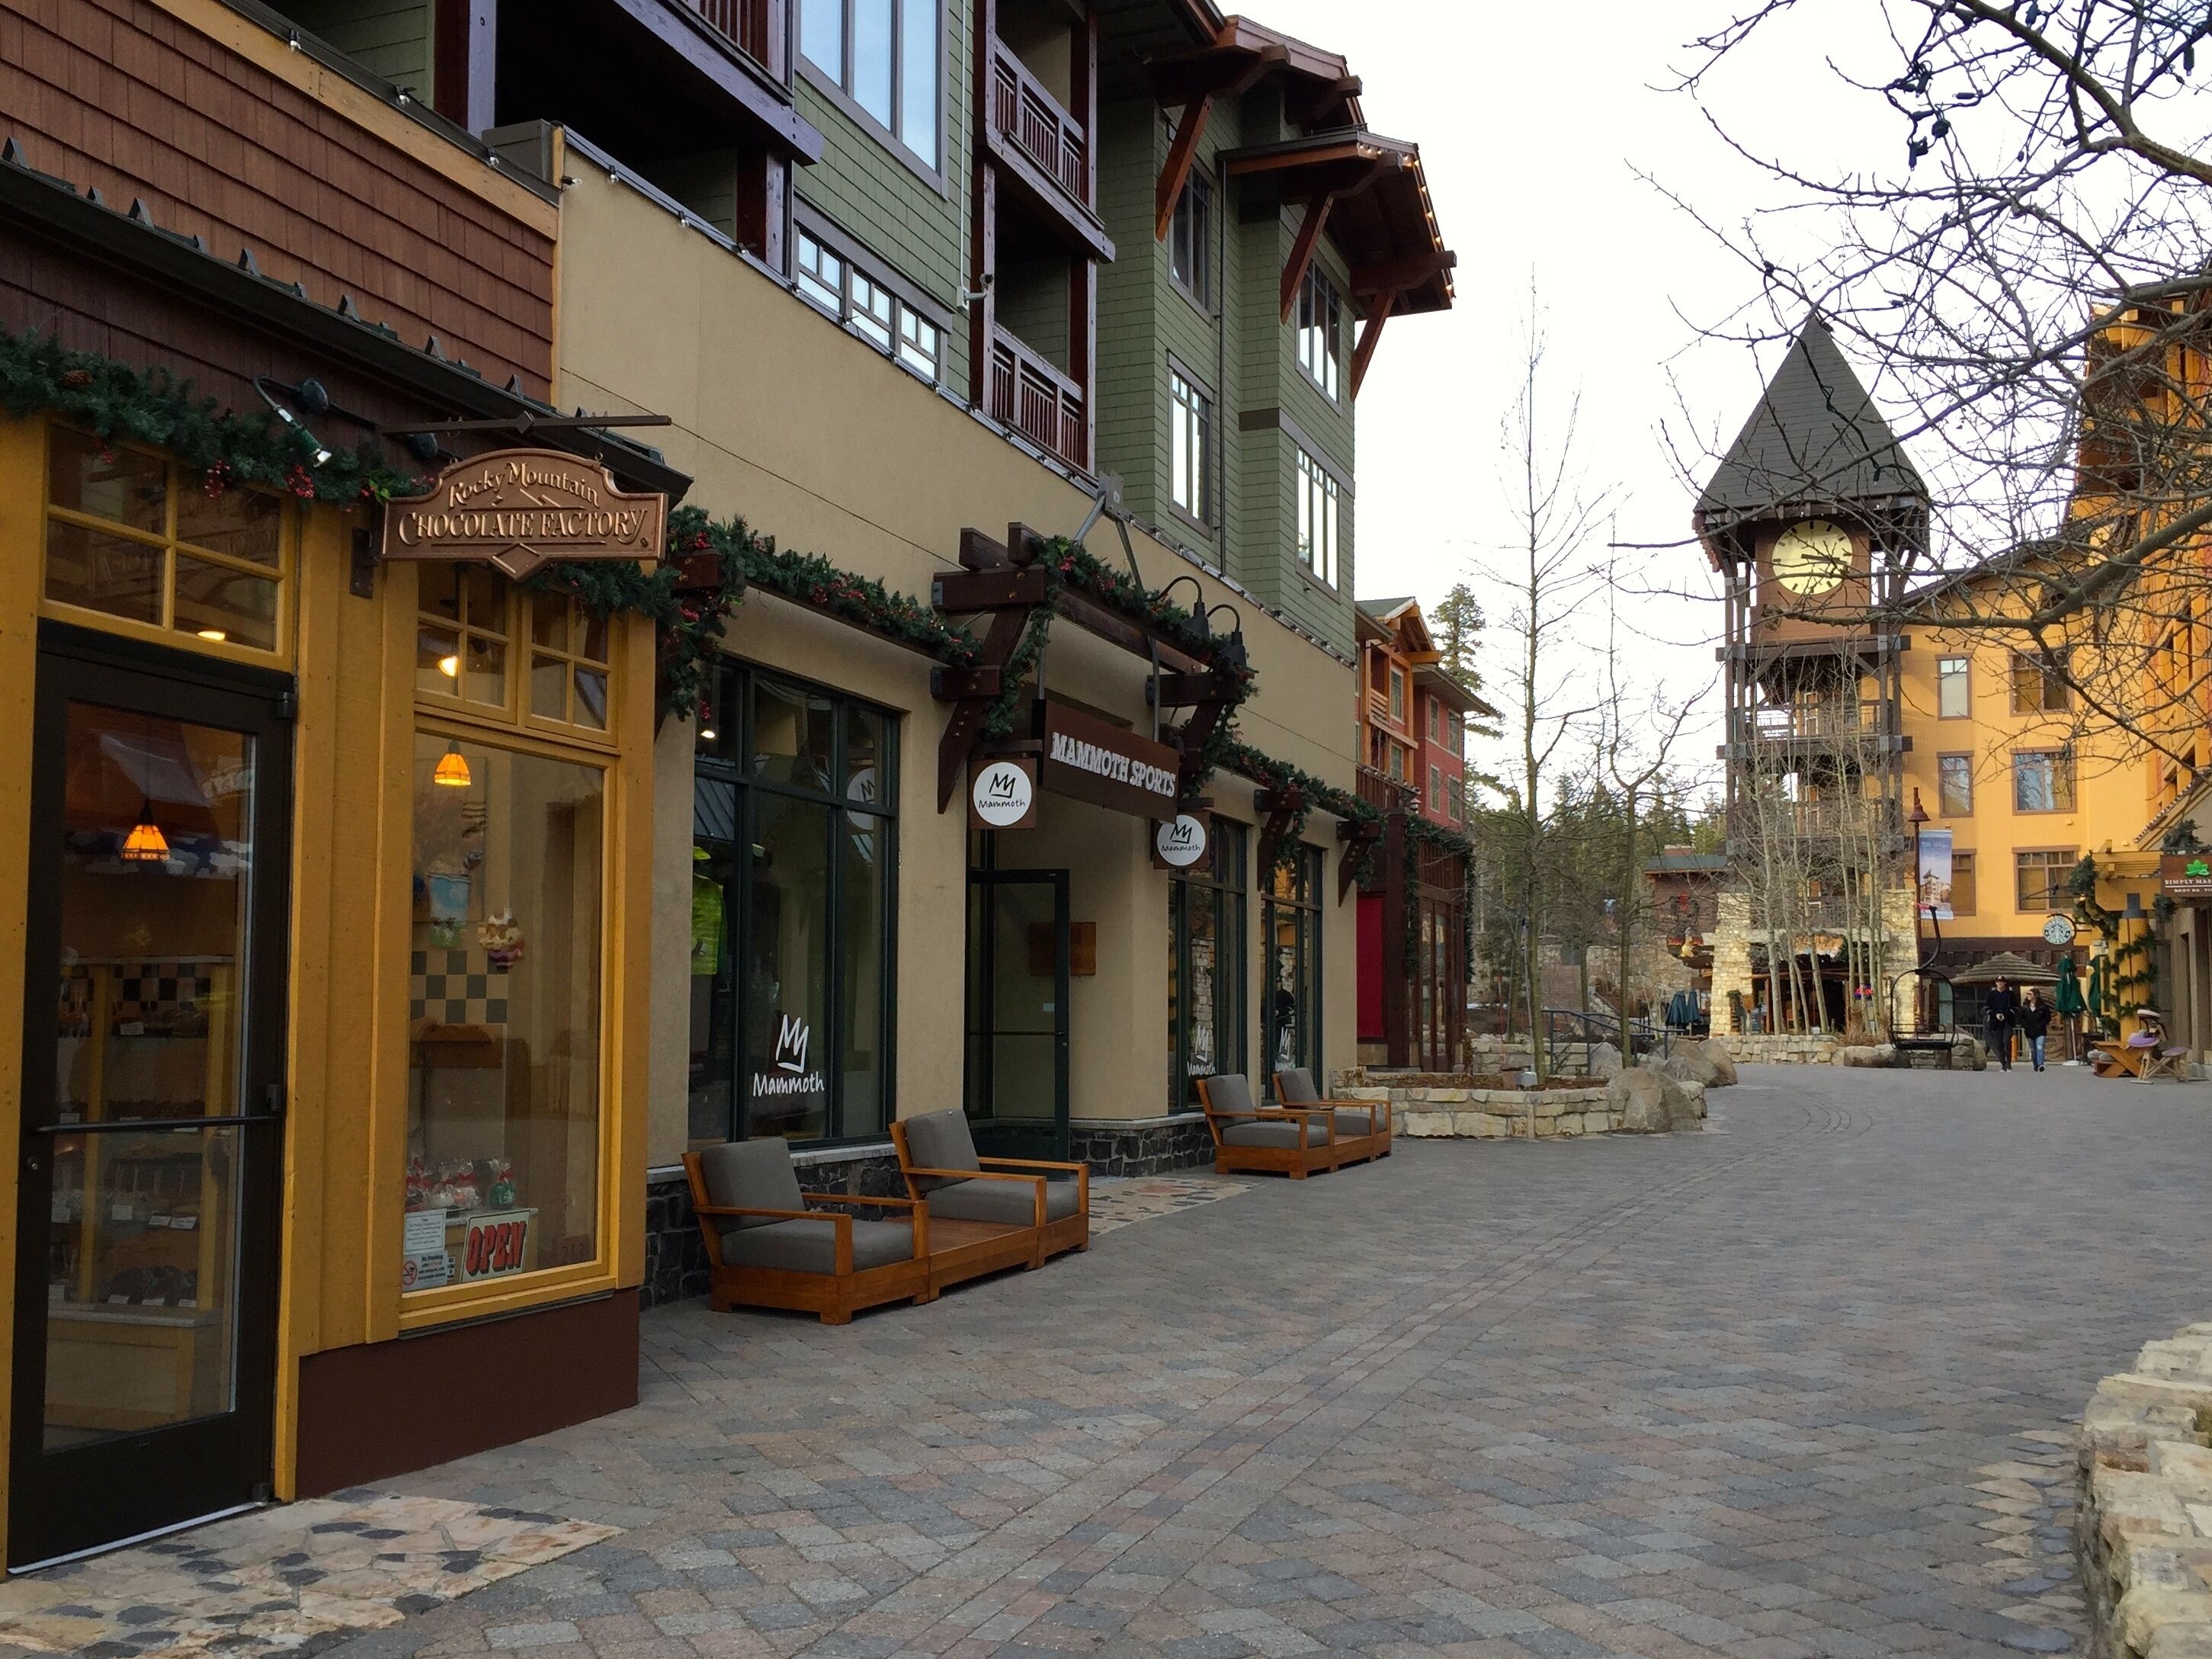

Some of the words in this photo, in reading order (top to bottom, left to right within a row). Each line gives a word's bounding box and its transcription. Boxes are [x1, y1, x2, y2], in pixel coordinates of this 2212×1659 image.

[448, 470, 505, 508] Rocky
[505, 461, 601, 509] Mountain
[399, 512, 534, 545] CHOCOLATE
[539, 509, 647, 545] FACTORY
[1049, 731, 1130, 783] MAMMOTH
[1129, 759, 1176, 798] SPORTS
[978, 799, 1026, 809] Mammoth
[1161, 844, 1201, 852] Mammoth
[752, 1070, 825, 1097] Mammoth
[465, 1221, 527, 1277] OPEN
